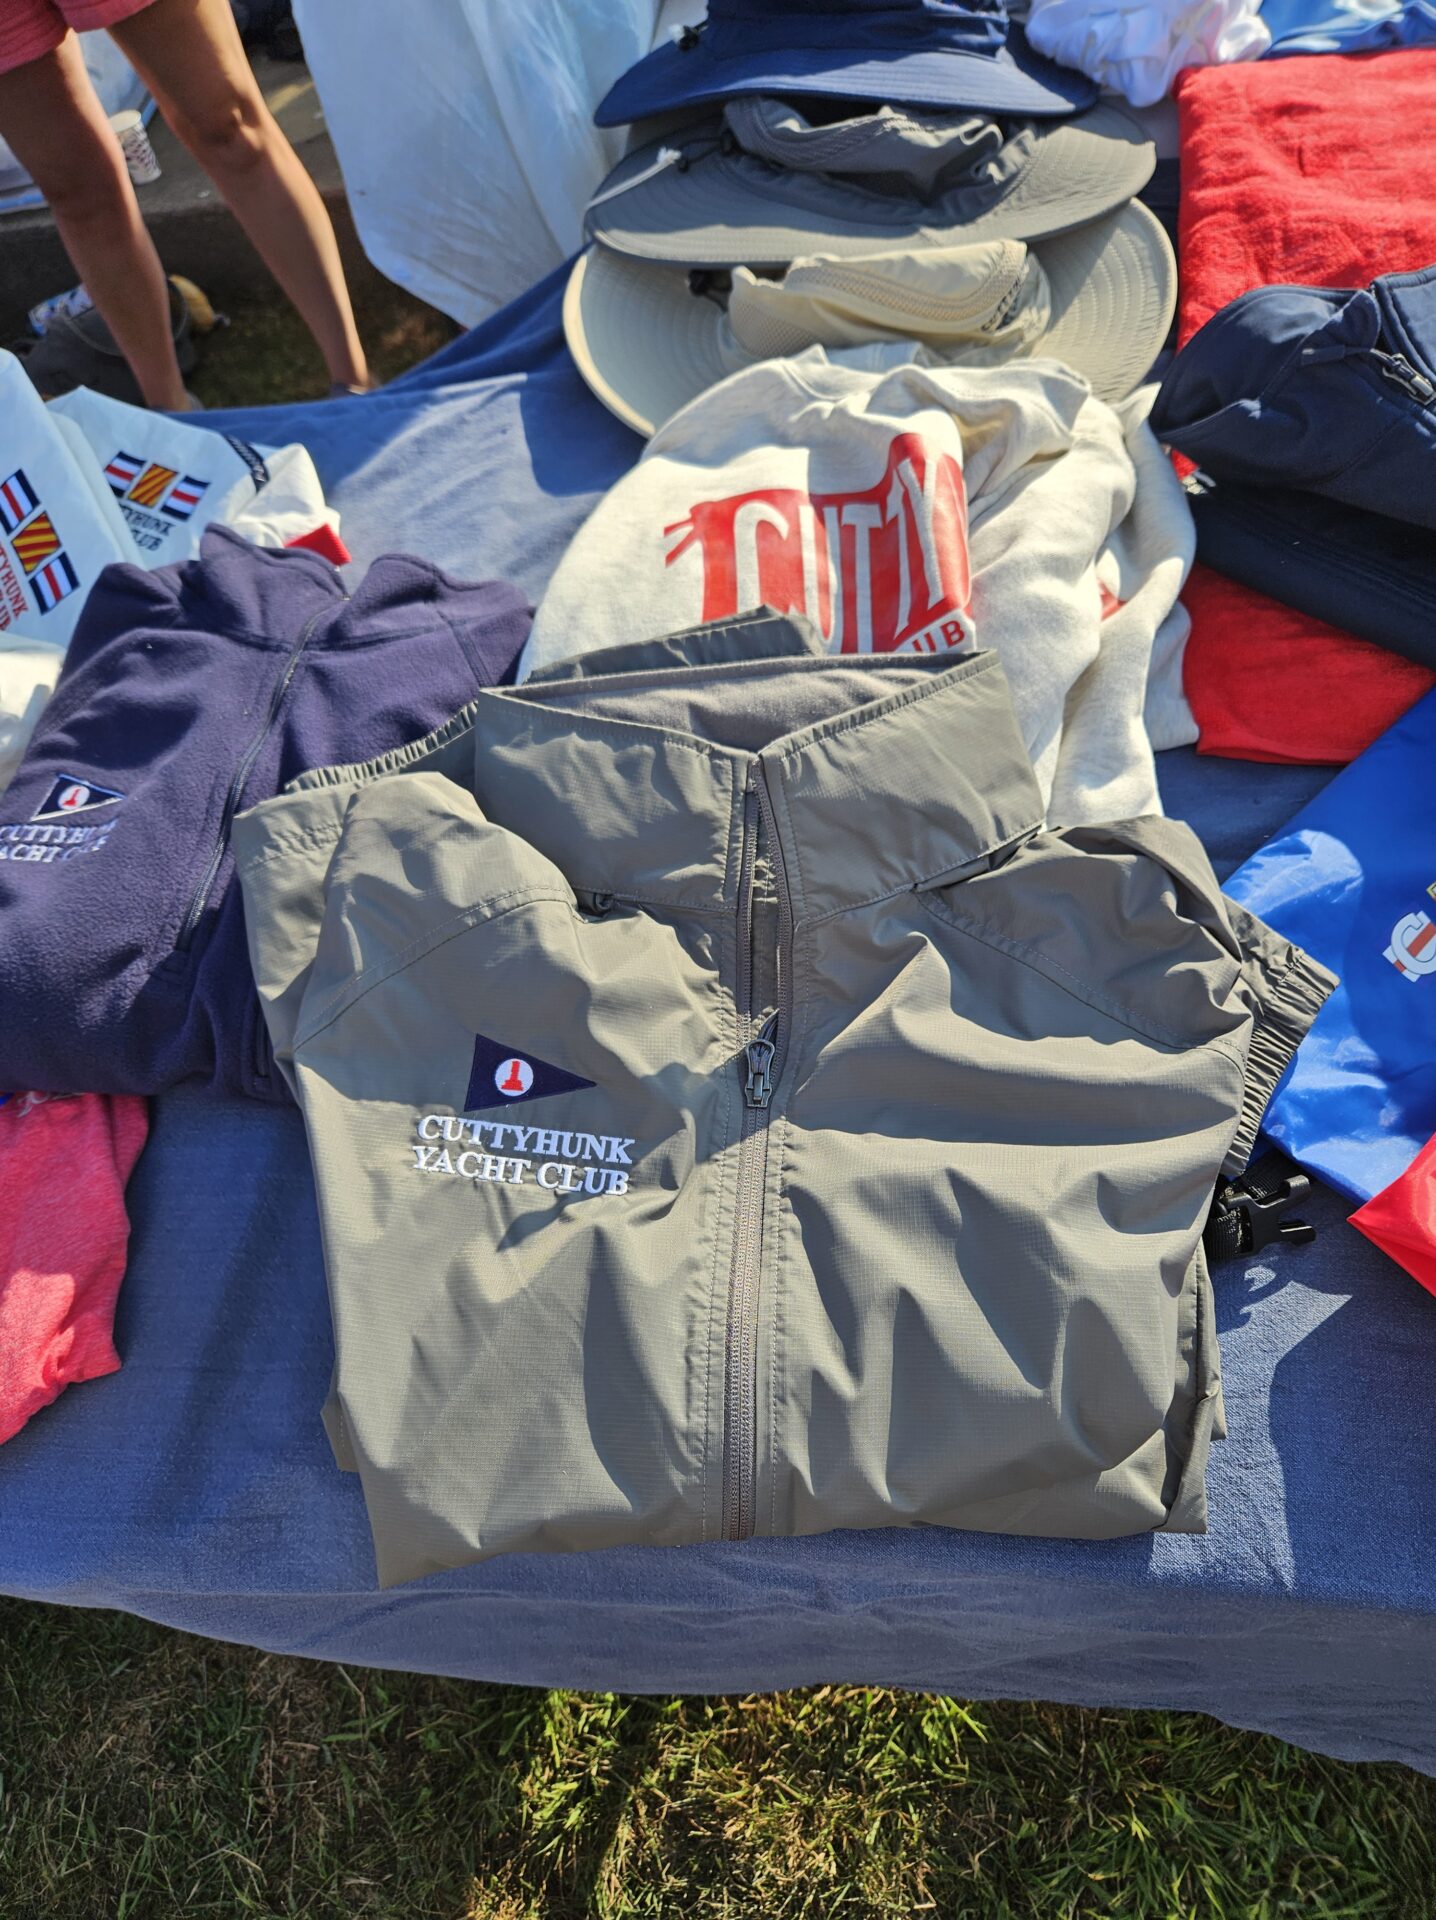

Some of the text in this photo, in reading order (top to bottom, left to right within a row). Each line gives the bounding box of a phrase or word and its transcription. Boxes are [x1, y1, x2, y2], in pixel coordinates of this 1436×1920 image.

[417, 1114, 636, 1165] CUTTYHUNK
[411, 1145, 630, 1196] YACHT CLUB
